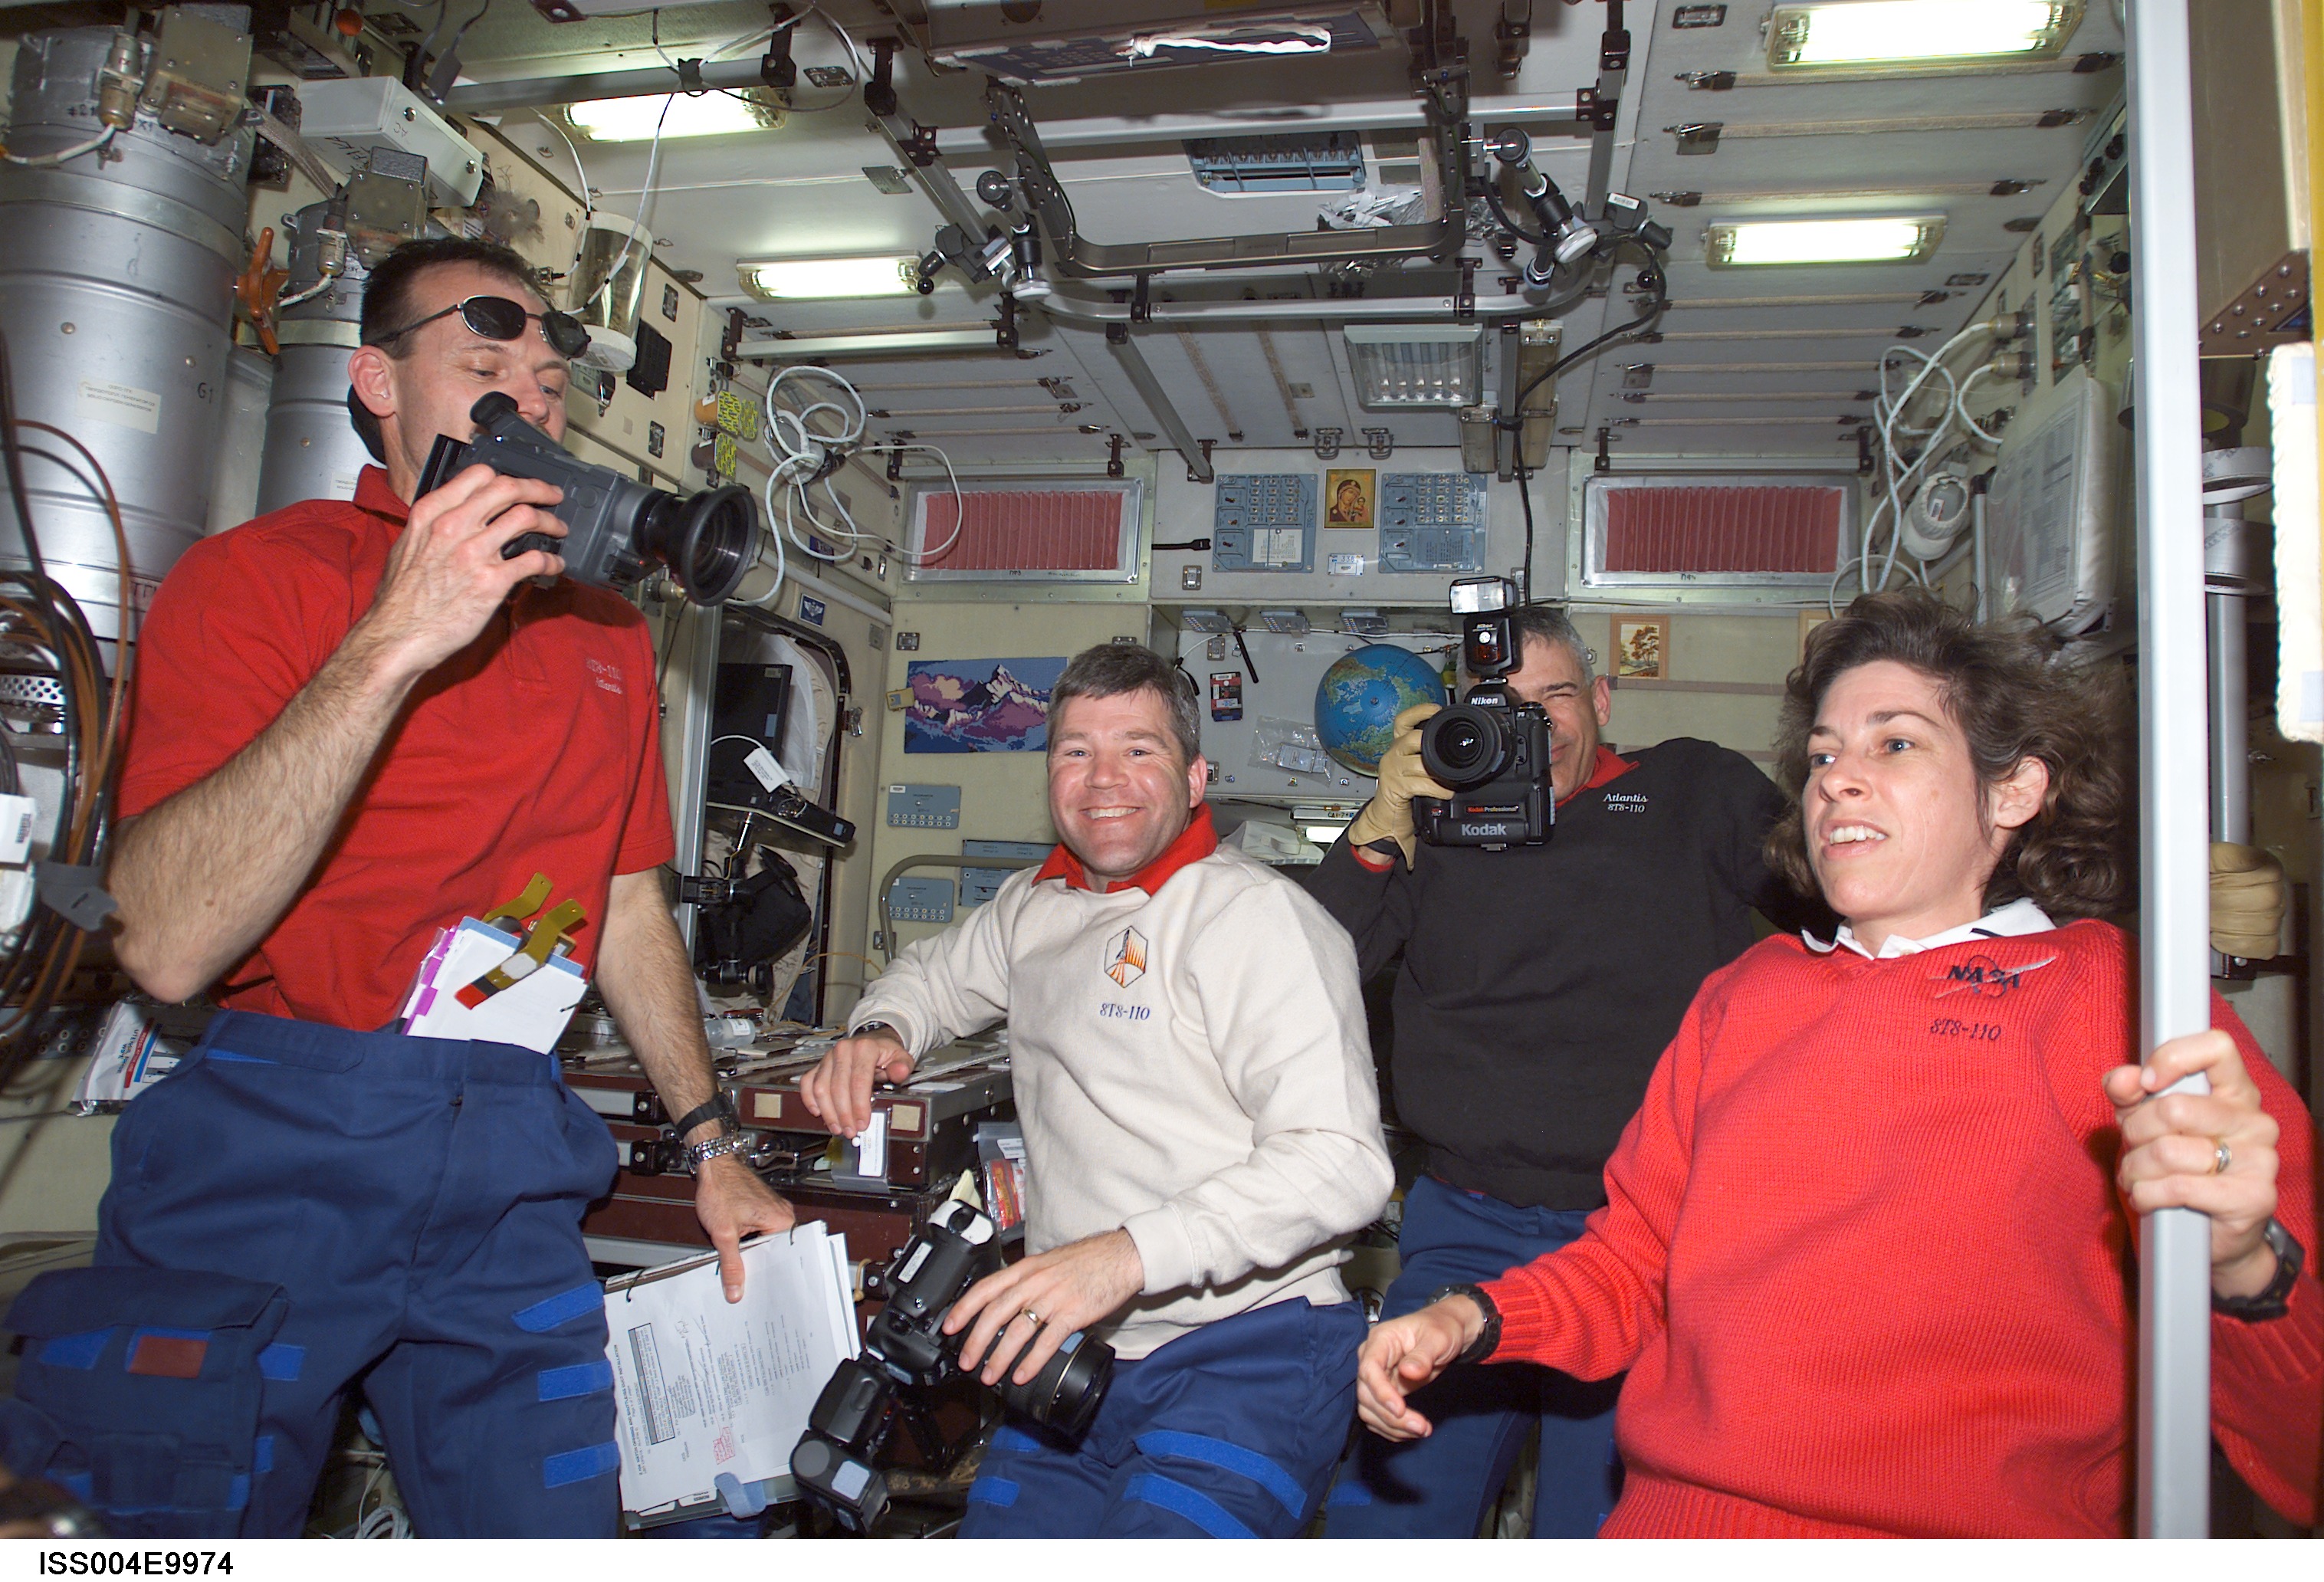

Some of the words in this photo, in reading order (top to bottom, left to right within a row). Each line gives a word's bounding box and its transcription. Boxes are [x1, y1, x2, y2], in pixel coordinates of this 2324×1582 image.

[1471, 697, 1498, 706] Nikon
[1602, 793, 1649, 802] Atlantis
[1607, 803, 1646, 813] STS-110
[1461, 823, 1508, 836] Kodak
[1946, 964, 2020, 990] NASA
[1099, 1003, 1151, 1021] STS-110
[1929, 1018, 2002, 1041] STS-110
